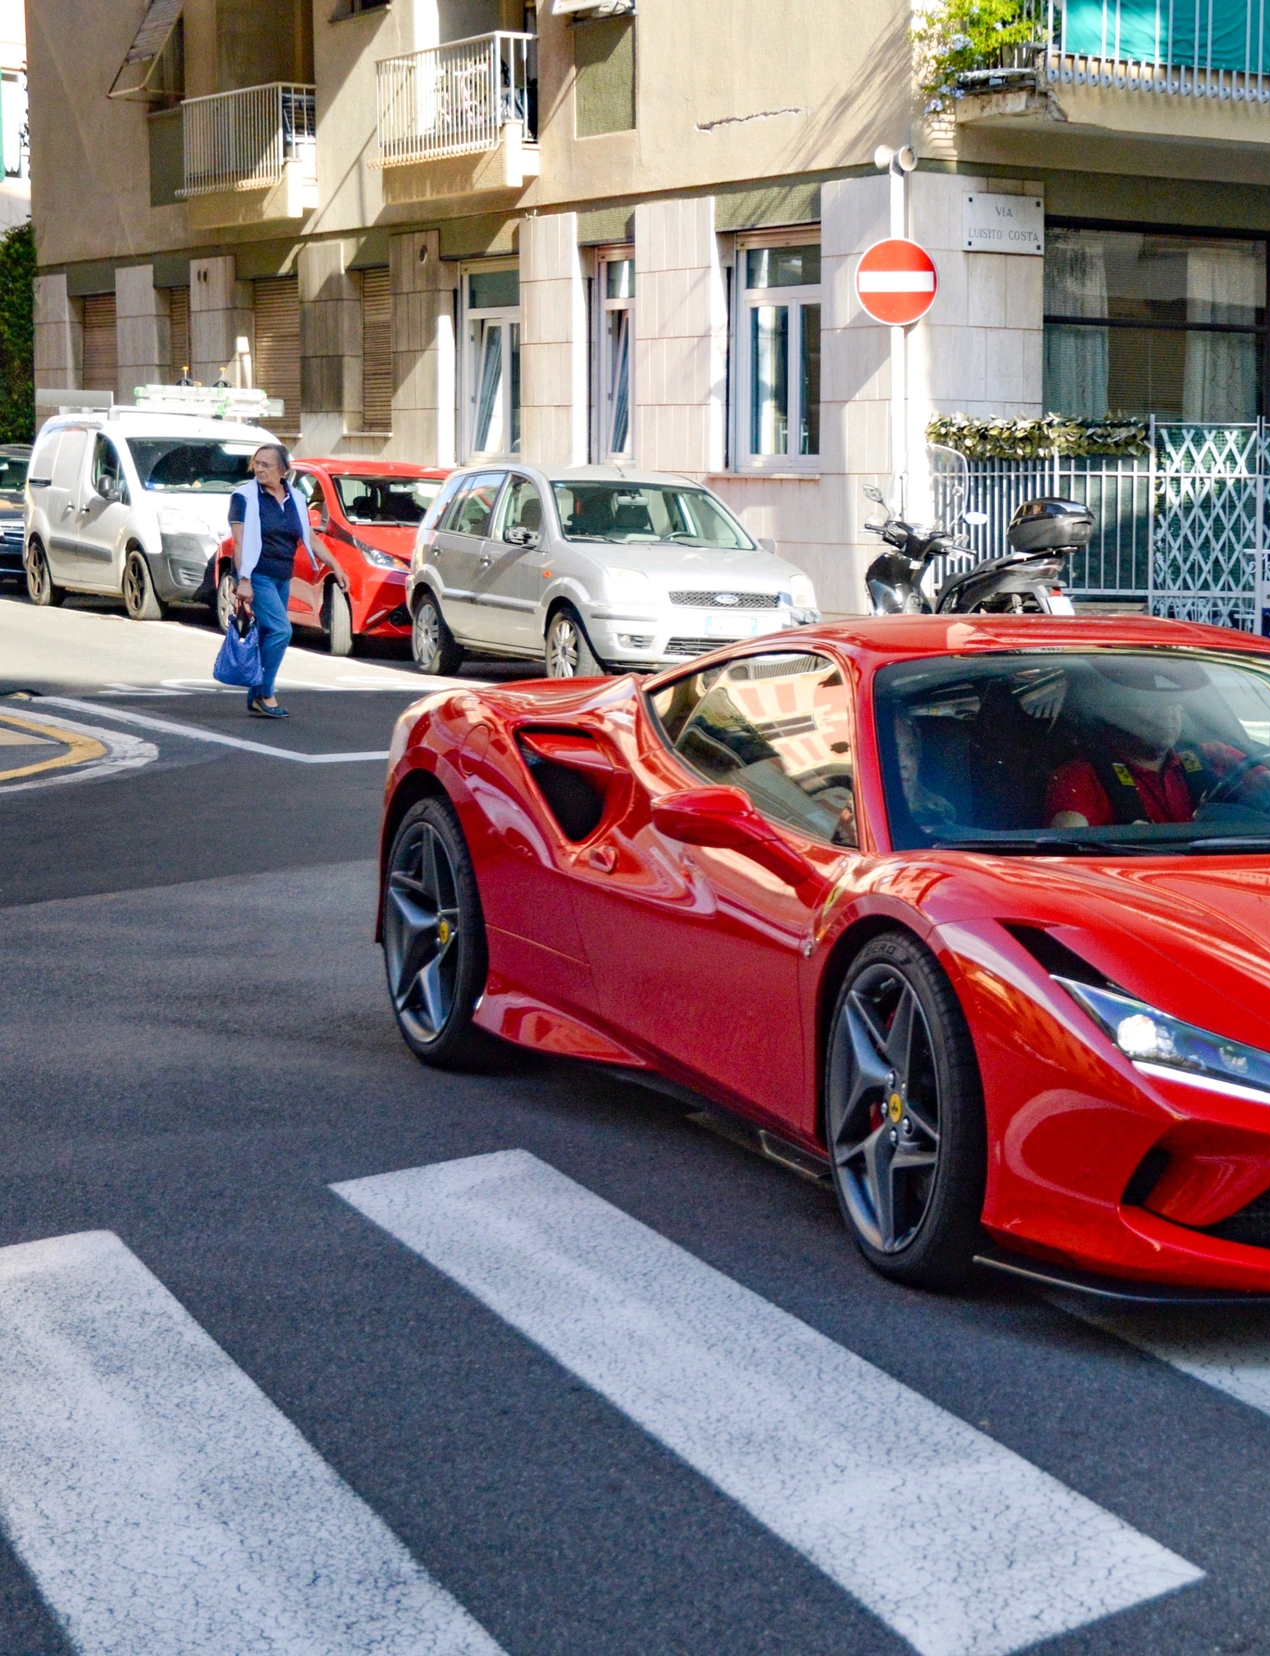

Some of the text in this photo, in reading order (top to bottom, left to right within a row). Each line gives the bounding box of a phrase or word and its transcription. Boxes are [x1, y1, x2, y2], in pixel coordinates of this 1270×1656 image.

[995, 206, 1013, 218] VIA
[968, 227, 1039, 242] LUISITO COSTA
